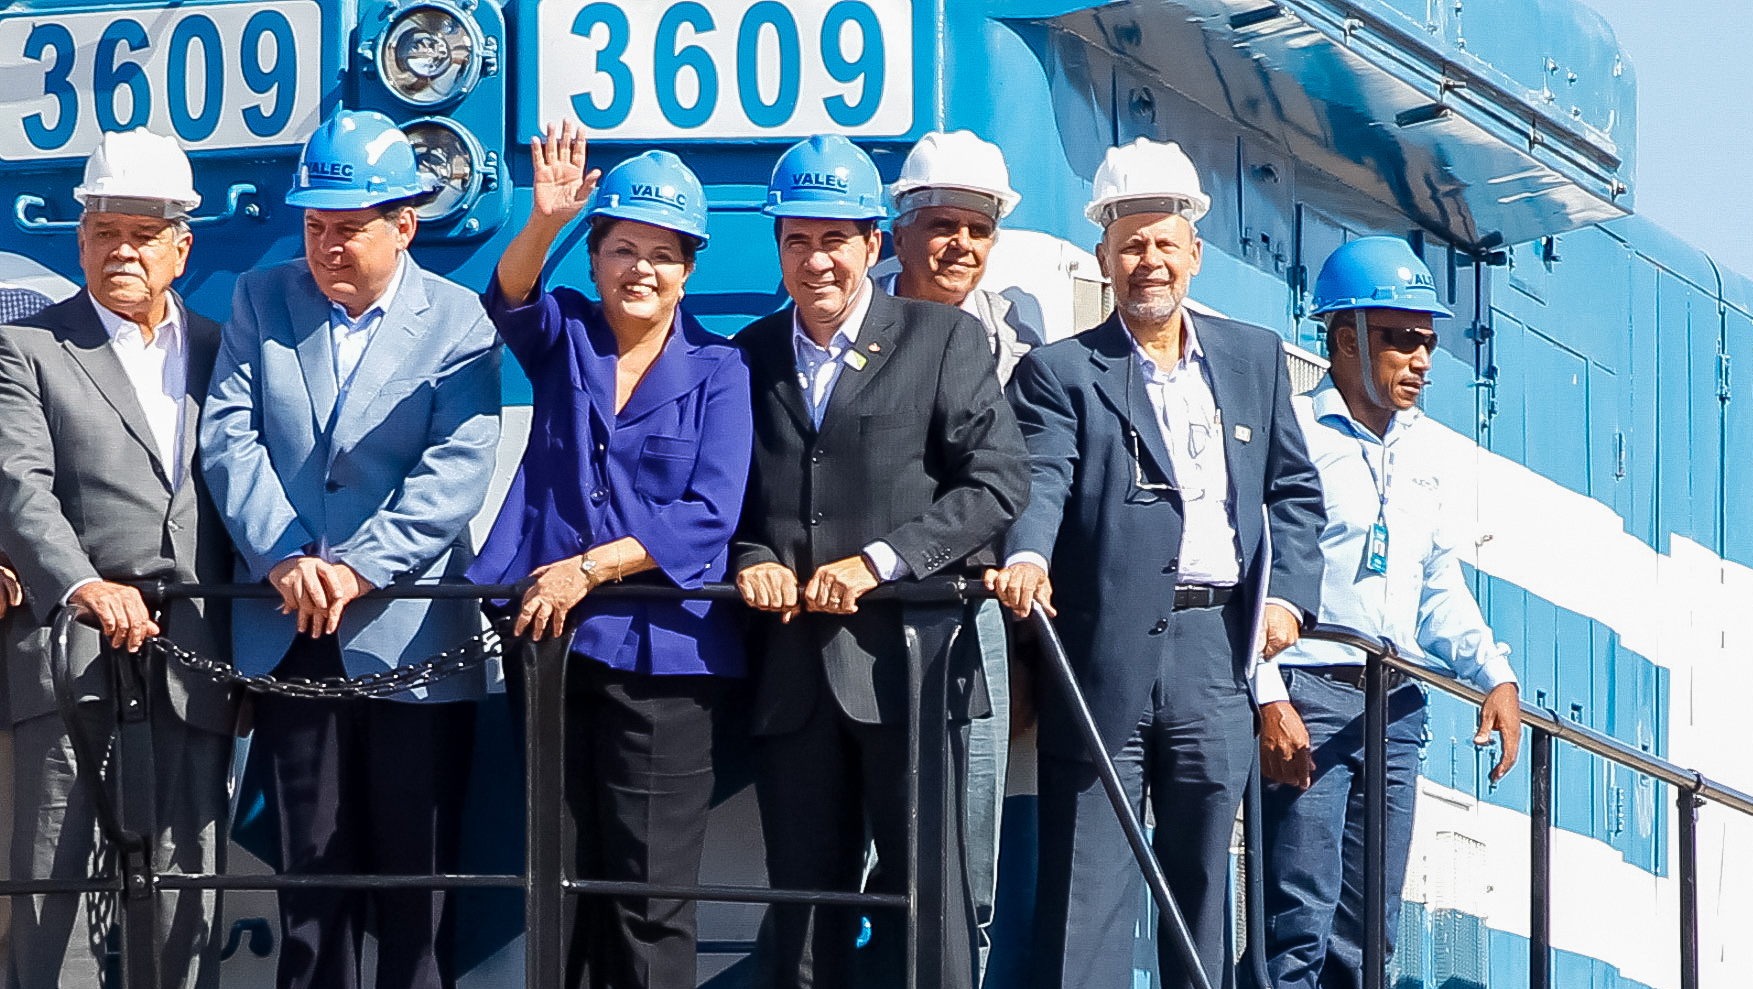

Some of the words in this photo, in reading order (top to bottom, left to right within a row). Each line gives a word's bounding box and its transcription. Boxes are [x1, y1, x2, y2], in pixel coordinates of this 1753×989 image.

[22, 9, 297, 150] 3609
[570, 1, 886, 130] 3609
[631, 184, 687, 206] VALC
